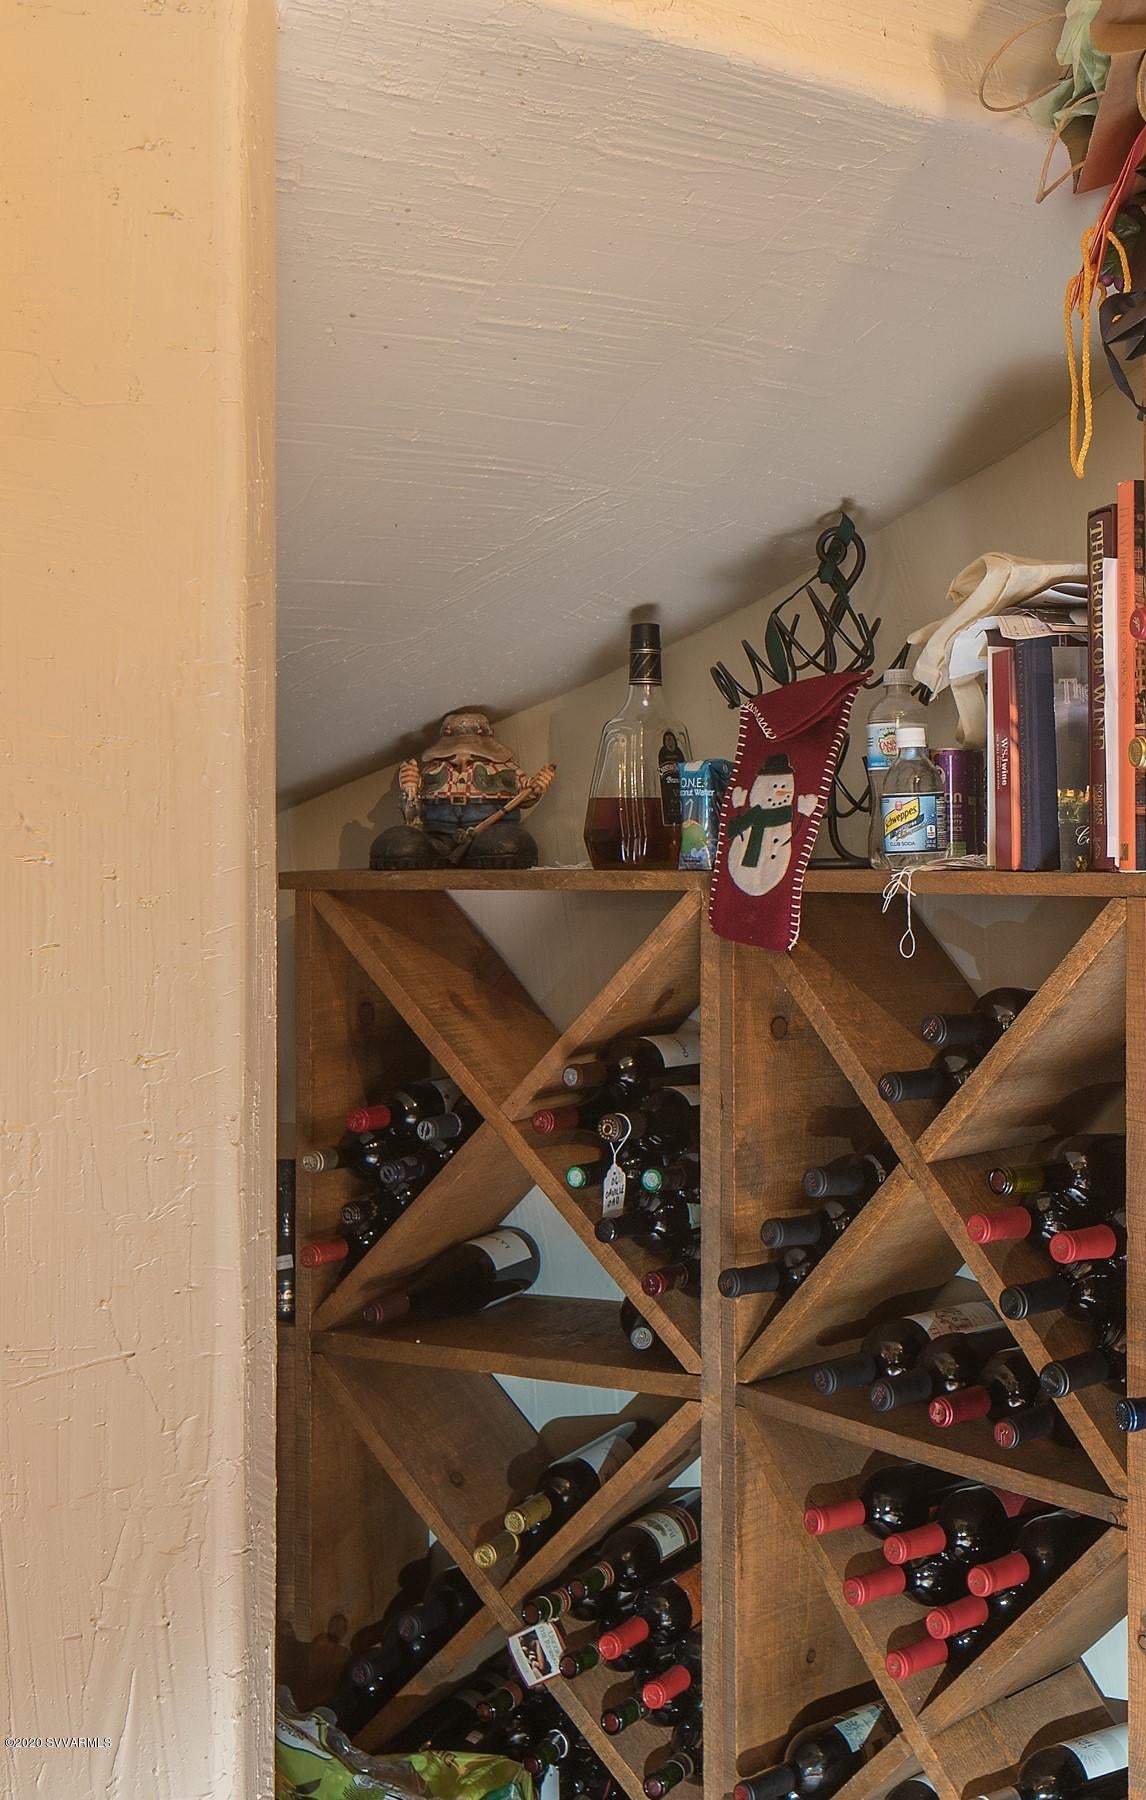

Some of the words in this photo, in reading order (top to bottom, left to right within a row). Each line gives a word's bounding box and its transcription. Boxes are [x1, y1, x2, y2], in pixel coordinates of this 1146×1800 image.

[1089, 520, 1104, 575] THE
[1093, 684, 1105, 751] WINE
[885, 805, 918, 829] Schweppes
